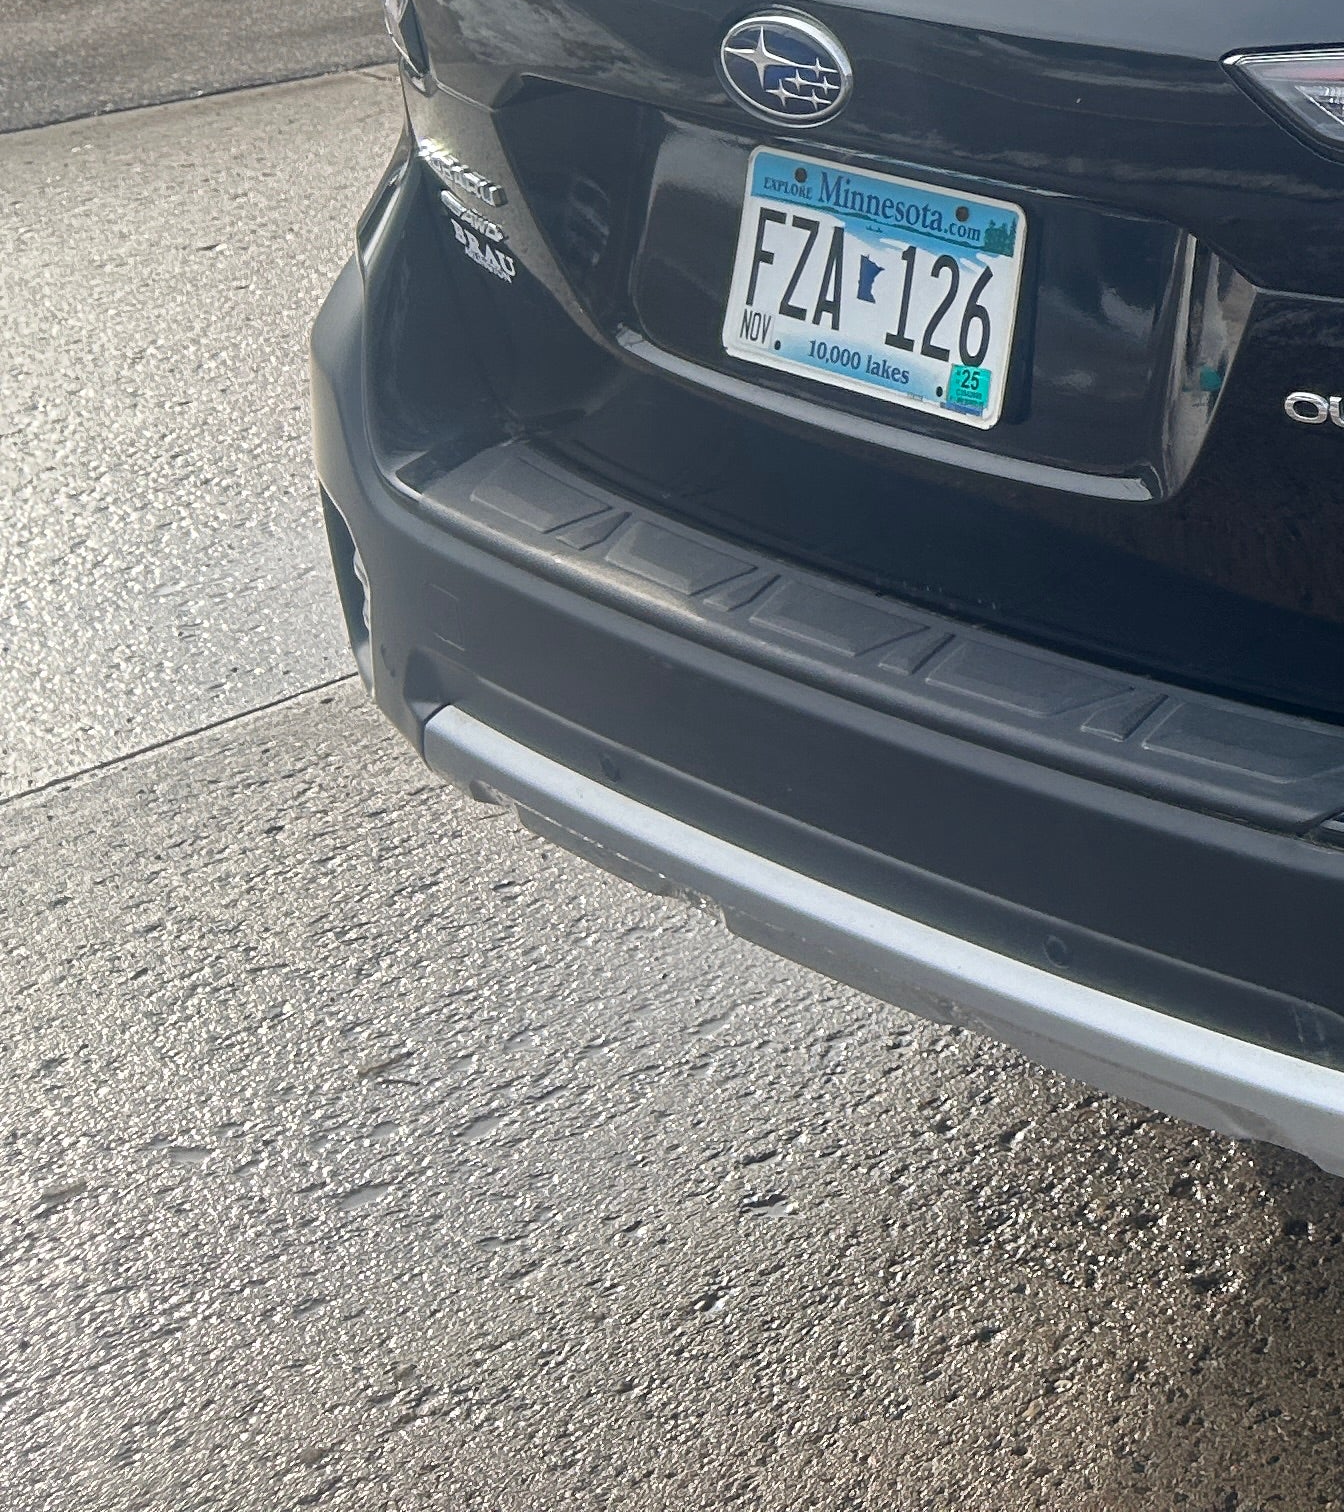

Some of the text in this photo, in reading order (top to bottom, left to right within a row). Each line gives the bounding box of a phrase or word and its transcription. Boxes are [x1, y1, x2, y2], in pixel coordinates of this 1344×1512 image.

[763, 171, 981, 242] EXPLORE Minnesota.com
[451, 218, 516, 276] BRAU
[745, 206, 993, 367] FZA 126
[740, 308, 772, 345] NOV
[808, 339, 910, 385] 10,000 lakes
[961, 369, 980, 390] 25
